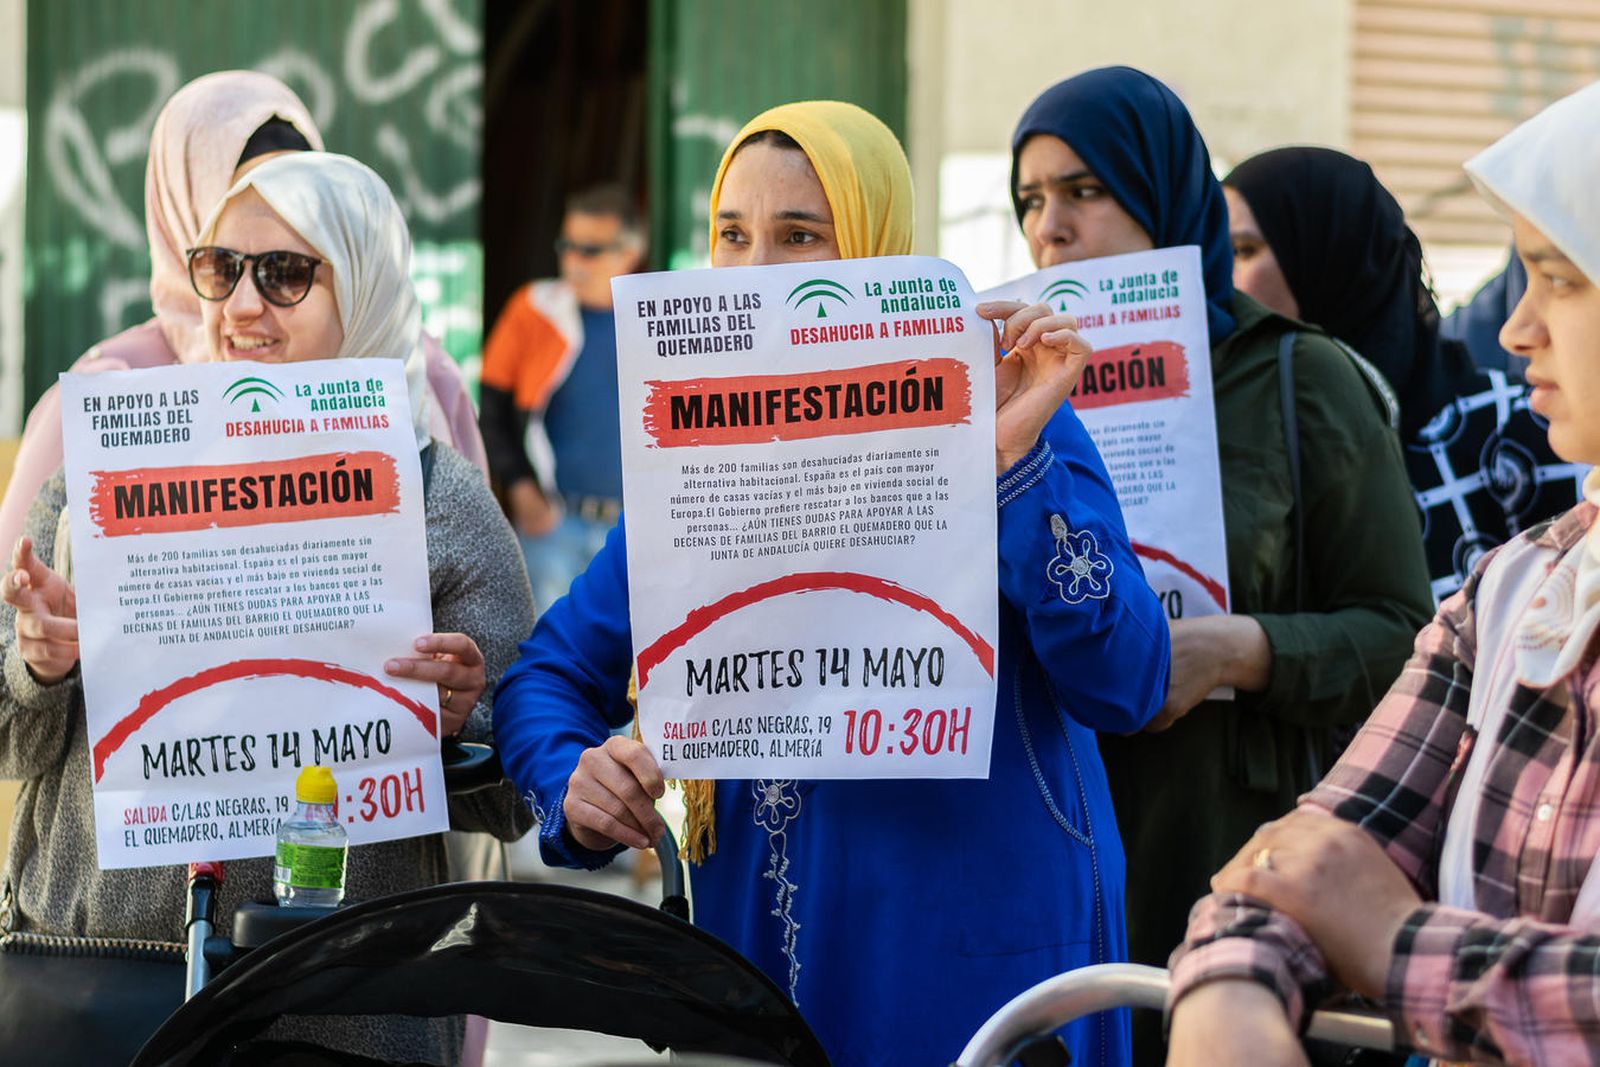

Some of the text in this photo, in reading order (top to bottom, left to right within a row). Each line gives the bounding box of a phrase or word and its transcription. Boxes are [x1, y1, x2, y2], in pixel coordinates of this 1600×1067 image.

[864, 277, 957, 297] La Junta de
[1099, 270, 1178, 292] La Junta de
[637, 293, 761, 318] EN APOYO A LAS
[1109, 312, 1117, 325] A
[1121, 305, 1180, 323] FAMILIAS
[647, 313, 756, 338] FAMILIAS DEL
[790, 316, 964, 345] DESAHUCIA A FAMILIAS
[657, 334, 753, 358] QUEMADERO
[83, 389, 199, 412] EN APOYO A LAS
[295, 378, 383, 397] La Junta de
[670, 366, 943, 430] MANIFESTACIÓN
[92, 409, 193, 430] FAMILIAS DEL
[225, 414, 389, 437] DESAHUCIA A FAMILIAS
[101, 427, 190, 448] QUEMADERO
[681, 447, 939, 475] Más de 200 familias son desahuciadas diariamente sin
[114, 458, 373, 519] MANIFESTACIÓN
[670, 476, 949, 505] número de casas vacías y el más bajo en vivienda social de
[683, 464, 934, 491] alternativa habitacional. España es el país con mayor
[716, 505, 761, 519] Gobierno
[764, 503, 801, 517] prefiere
[803, 499, 842, 513] rescatar
[845, 498, 850, 506] a
[853, 495, 867, 505] los
[870, 493, 903, 503] bancos
[906, 493, 923, 503] que
[926, 493, 932, 501] a
[935, 490, 949, 501] las
[687, 523, 738, 535] personas...
[770, 515, 802, 528] TIENES
[805, 511, 836, 525] DUDAS
[839, 508, 865, 521] PARA
[866, 505, 904, 520] APOYAR
[907, 505, 914, 516] A
[916, 505, 934, 516] LAS
[674, 519, 947, 549] DECENAS DE FAMILIAS DEL BARRIO EL QUEMADERO QUE LA
[710, 534, 916, 561] JUNTA DE ANDALUCÍA QUIERE DESAHUCIAR?
[685, 646, 945, 697] MARTES 14 MAYO
[663, 715, 832, 740] SALIDA C/LAS NEGRAS, 19
[843, 707, 971, 756] 10:30H
[141, 719, 392, 780] MARTES 14 MAYO
[662, 743, 678, 761] EL
[682, 739, 764, 760] QUEMADERO,
[334, 767, 425, 823] :30H
[124, 796, 289, 825] SALIDA C/LAS NEGRAS, 19
[125, 830, 139, 848] EL
[144, 822, 224, 846] QUEMADERO,
